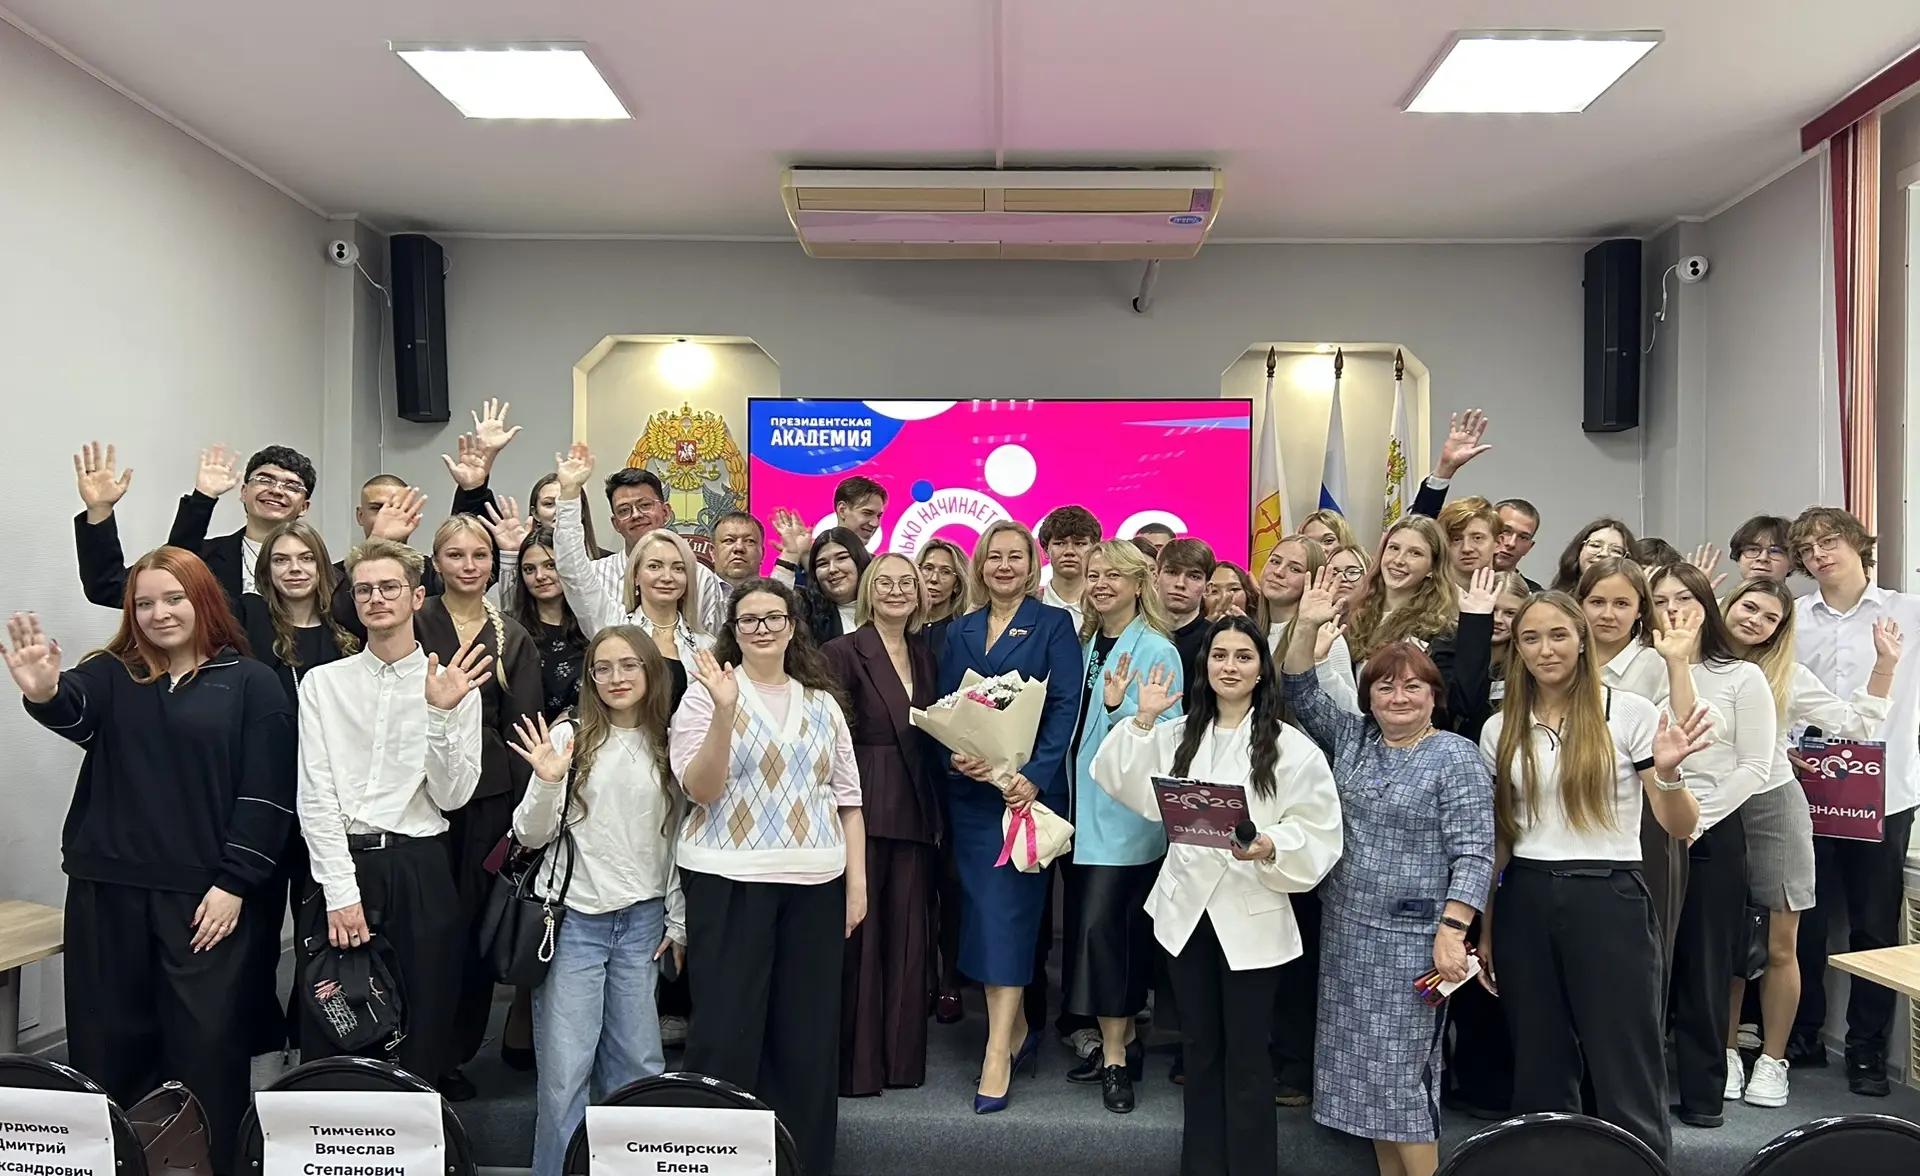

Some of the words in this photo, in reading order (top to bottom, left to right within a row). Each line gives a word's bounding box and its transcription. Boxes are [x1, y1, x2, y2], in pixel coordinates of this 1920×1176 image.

[770, 417, 872, 427] ПРЕЗИДЕНТСКАЯ
[770, 429, 872, 447] АКАДЕМИЯ
[309, 1125, 396, 1136] Тимченко
[315, 1143, 395, 1155] Вячеслав
[626, 1141, 738, 1156] Симбирских
[303, 1163, 405, 1176] Степанович
[656, 1161, 709, 1173] Елена
